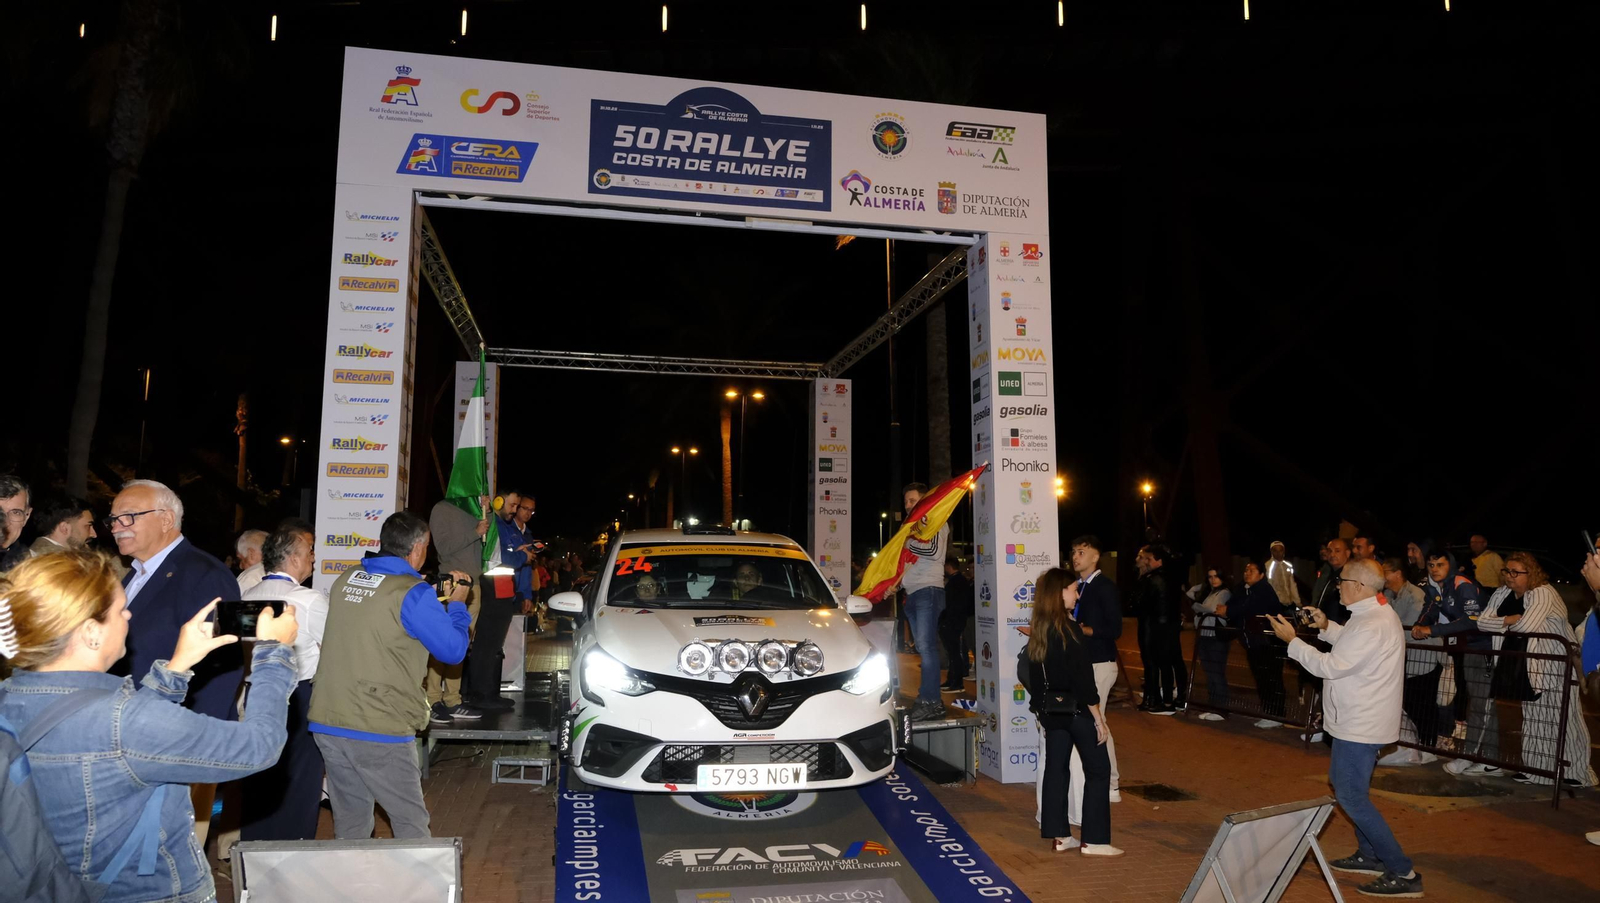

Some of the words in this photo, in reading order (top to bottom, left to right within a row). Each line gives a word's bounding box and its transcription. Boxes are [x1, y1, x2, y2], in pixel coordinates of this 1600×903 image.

[381, 107, 409, 115] Federación
[410, 110, 433, 118] Española
[526, 102, 550, 111] Consejo
[701, 109, 726, 117] RALLYE
[385, 115, 424, 123] Automovilismo
[534, 114, 560, 122] Deportes
[450, 141, 521, 159] CERA
[613, 124, 661, 150] 50
[663, 128, 811, 163] RALLYE
[463, 164, 508, 176] Recalvi
[612, 151, 681, 170] COSTA
[684, 157, 712, 172] DE
[715, 160, 808, 180] ALMERÍA
[874, 185, 909, 196] COSTA
[911, 188, 925, 197] DE
[863, 196, 926, 212] ALMERÍA
[962, 193, 1030, 208] DIPUTACIÓN
[963, 205, 978, 215] DE
[980, 206, 1028, 219] ALMERÍA
[344, 253, 399, 267] Rallycar
[350, 279, 388, 291] Recalvi
[338, 345, 393, 359] Rallycar
[997, 347, 1047, 362] MOYA
[344, 371, 383, 383] Recalvi
[1000, 379, 1020, 388] UNED
[1000, 404, 1048, 419] gasolia
[332, 437, 388, 451] Rallycar
[819, 444, 847, 452] MOYA
[339, 465, 378, 476] Recalvi
[1002, 458, 1049, 472] Phonika
[819, 476, 848, 484] gasolia
[819, 507, 847, 516] Phonika
[326, 534, 381, 548] Rallycar
[616, 556, 653, 576] 24
[342, 586, 375, 597] FOTO/TV
[344, 595, 363, 603] 2025
[1010, 752, 1037, 772] arg
[712, 768, 758, 785] 5793
[767, 767, 801, 784] NGW
[712, 808, 793, 819] ALMERIA
[685, 862, 750, 873] FEDERACIÓN
[772, 858, 859, 869] AUTOMOVILISMO
[772, 865, 836, 874] COMUNITAT
[839, 861, 902, 871] VALENCIANA
